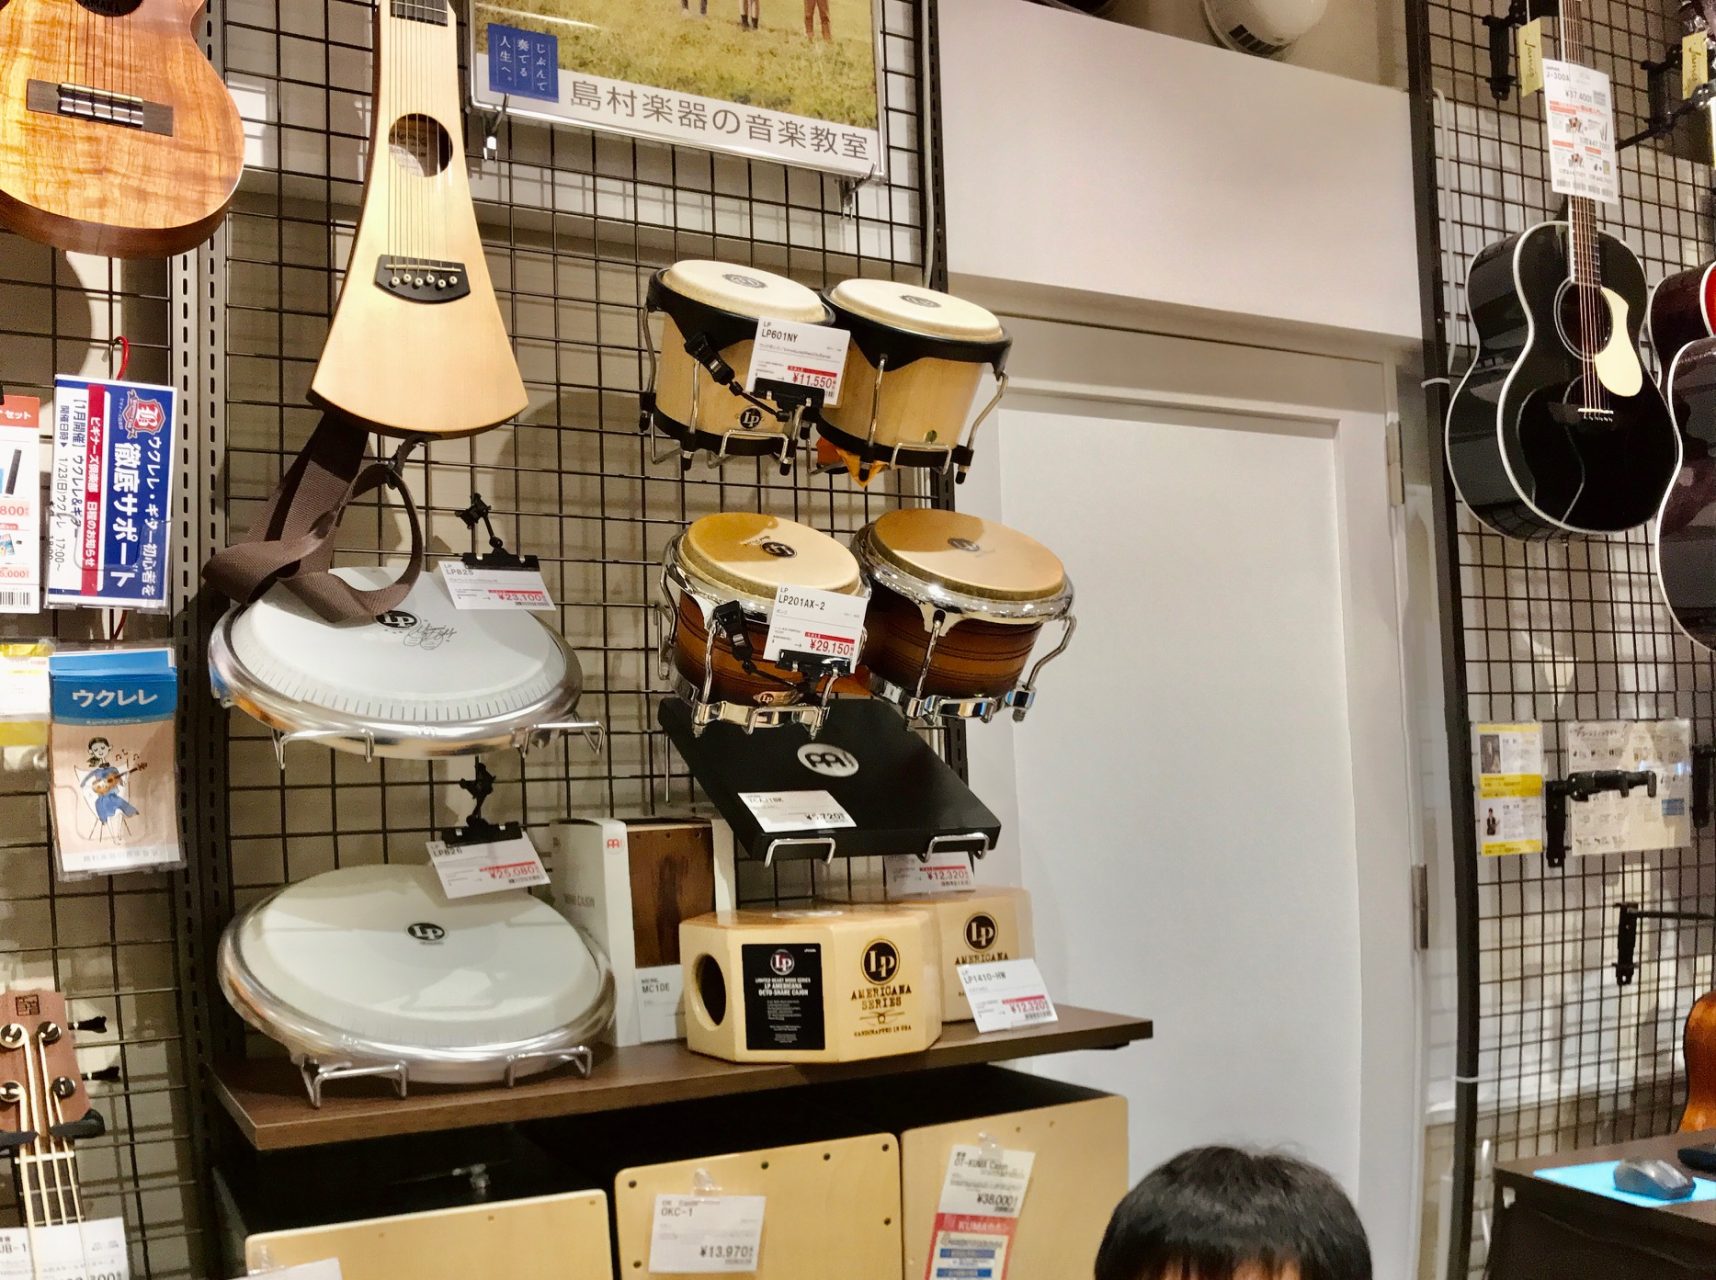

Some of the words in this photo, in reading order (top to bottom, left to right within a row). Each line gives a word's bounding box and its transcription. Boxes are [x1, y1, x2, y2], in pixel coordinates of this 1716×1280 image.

[570, 79, 870, 161] 島村楽器の音楽教室
[761, 328, 798, 343] LP601NY
[792, 373, 832, 389] ¥11,550
[110, 442, 142, 588] 徹底サポート
[141, 435, 162, 596] ウクレレ・ギター初心者を
[778, 594, 826, 610] LP201AX-2
[809, 639, 850, 656] ¥29,150
[72, 688, 158, 708] ウクレレ
[413, 925, 443, 940] LP
[971, 921, 995, 947] LP
[774, 954, 792, 971] LP
[869, 950, 895, 978] LP
[851, 984, 912, 1001] AMERICANA
[861, 996, 902, 1010] SERIES
[661, 1207, 693, 1217] OKC-1
[700, 1245, 750, 1258] ¥13,970
